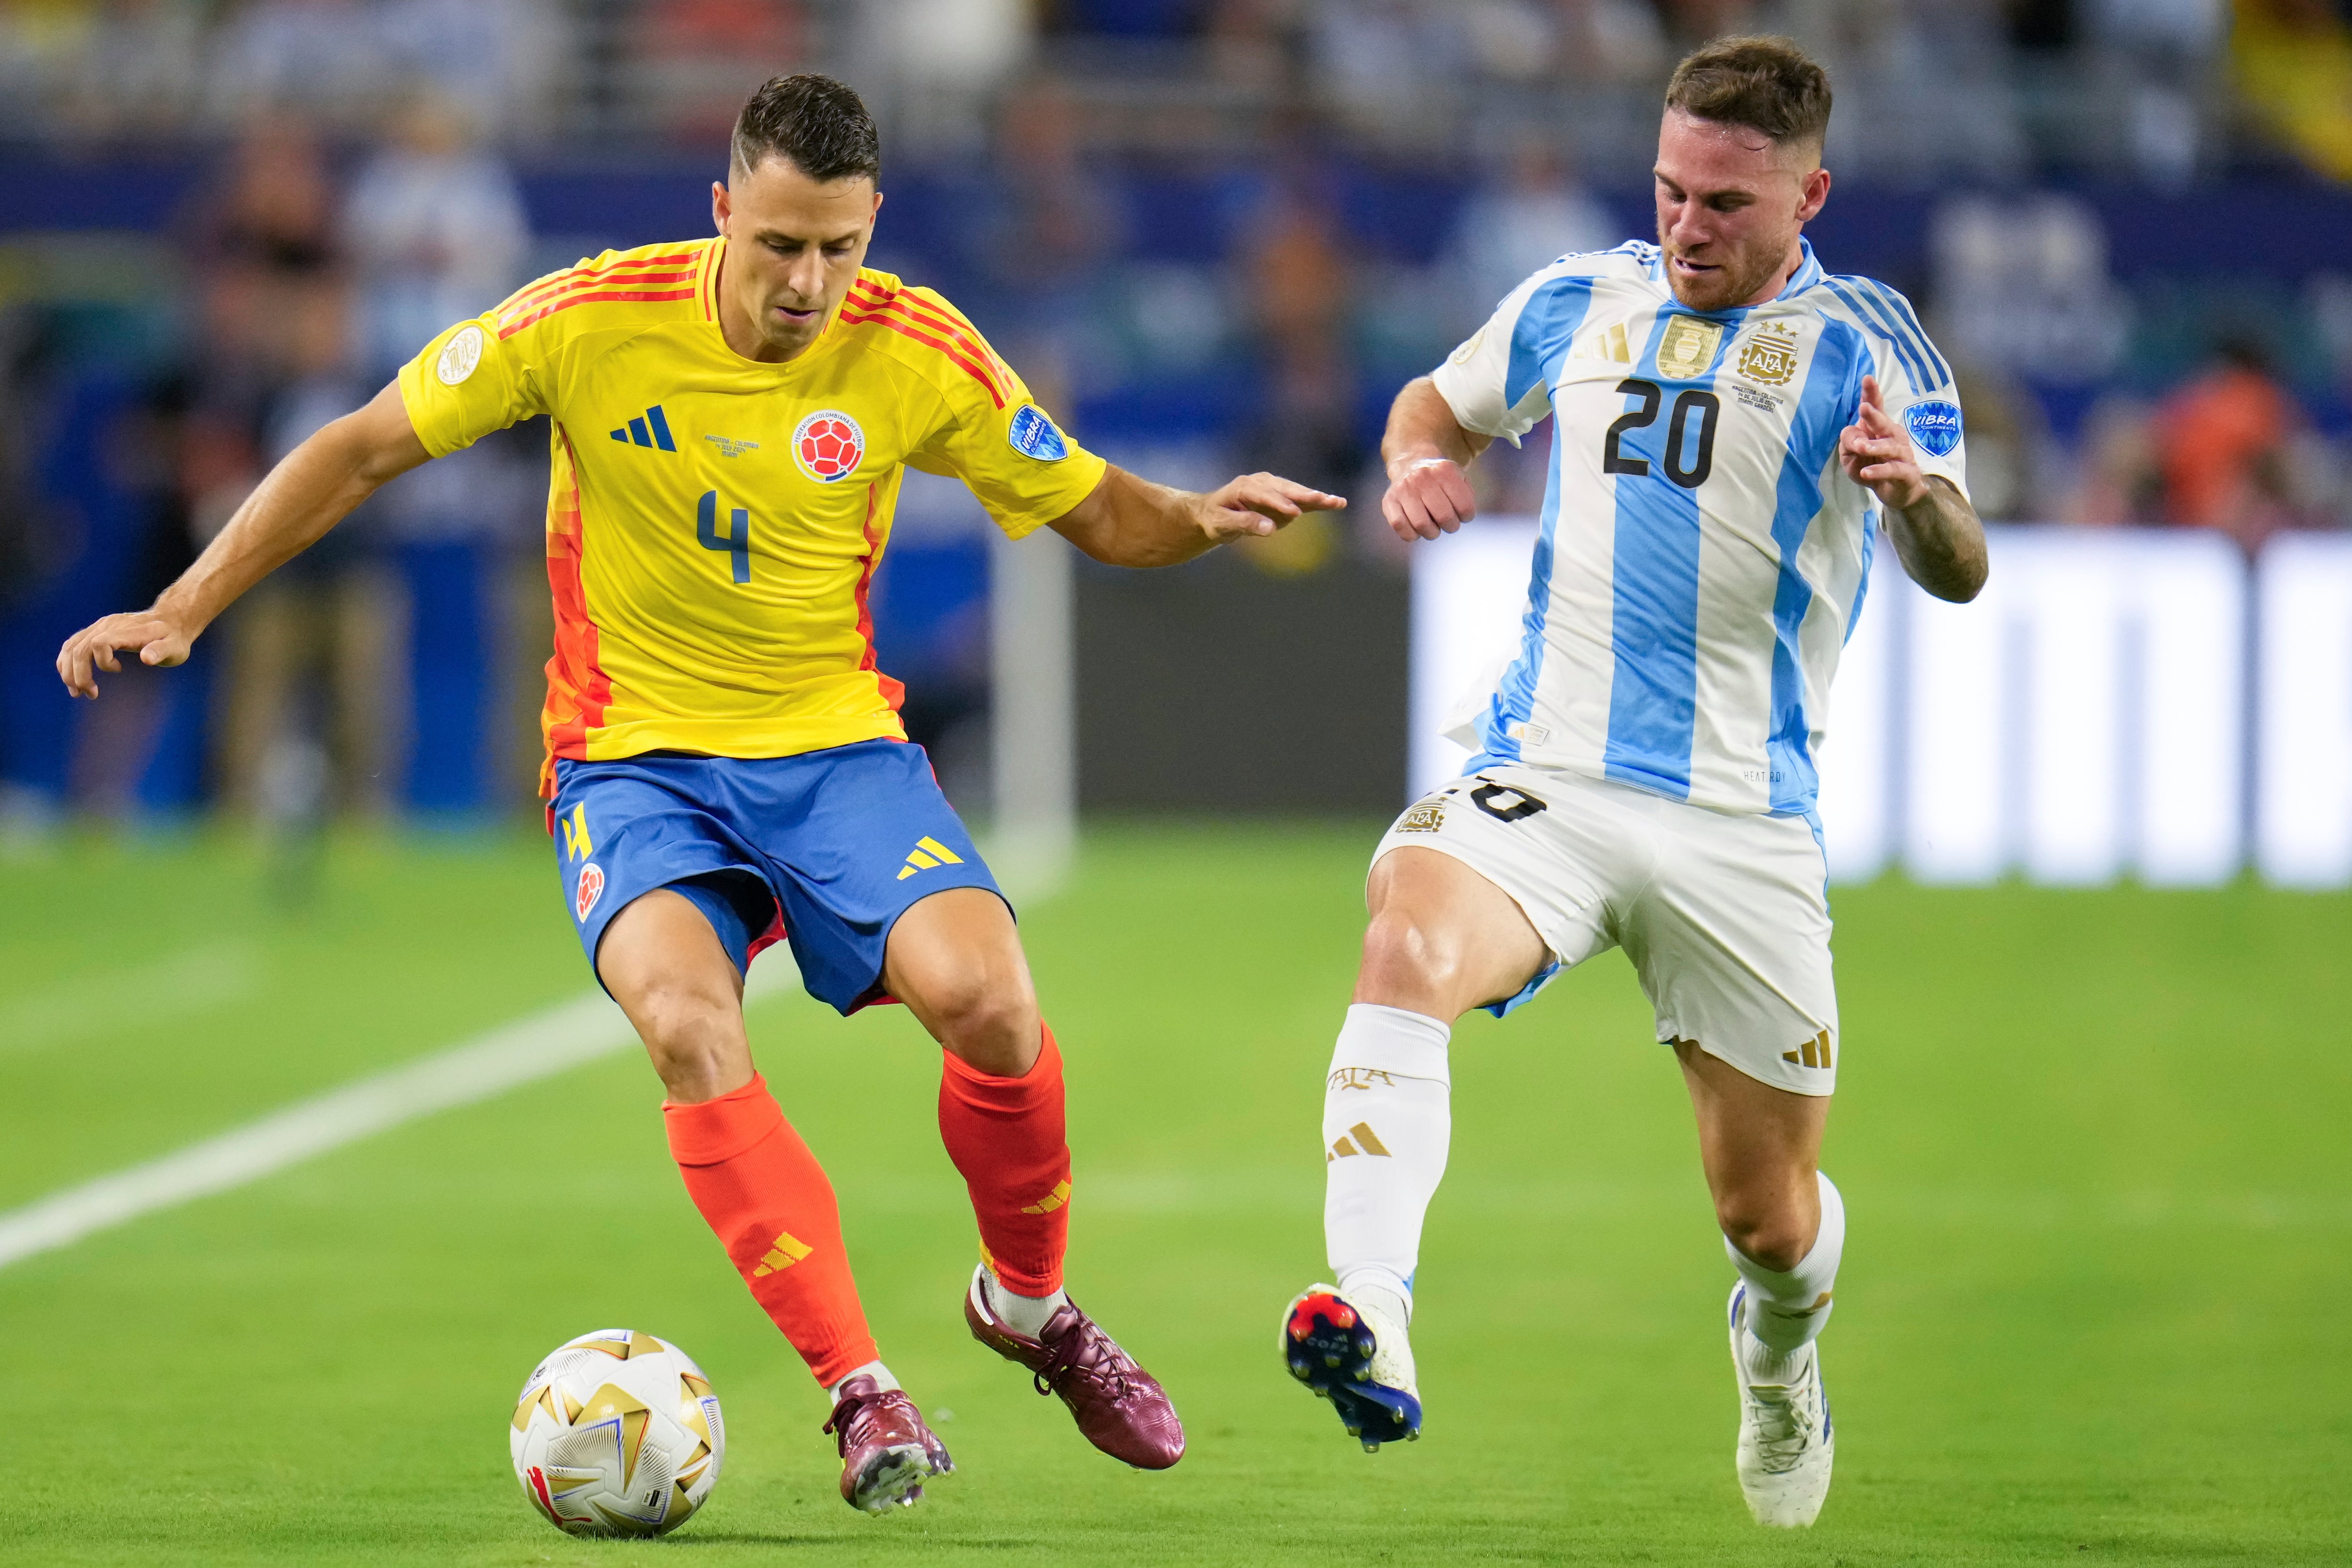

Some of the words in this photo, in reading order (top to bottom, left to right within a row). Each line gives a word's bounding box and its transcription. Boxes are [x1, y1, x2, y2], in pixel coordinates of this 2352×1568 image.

[1750, 347, 1783, 373] AFA
[1732, 385, 1756, 395] ARGENTINA
[1761, 393, 1784, 405] COLOMBIA
[1738, 397, 1753, 406] MIAMI
[1754, 402, 1774, 413] GARDENS
[1764, 399, 1776, 408] 2024
[816, 412, 850, 424] COLOMBIANA
[1913, 415, 1956, 427] VIBRA
[1021, 415, 1042, 450] VIBRA
[1604, 378, 1720, 489] 20
[704, 435, 730, 444] ARGENTINA
[735, 440, 759, 449] COLOMBIA
[697, 490, 751, 584] 4
[1406, 810, 1432, 825] AFA
[562, 801, 593, 863] 4
[999, 1335, 1019, 1349] COPA
